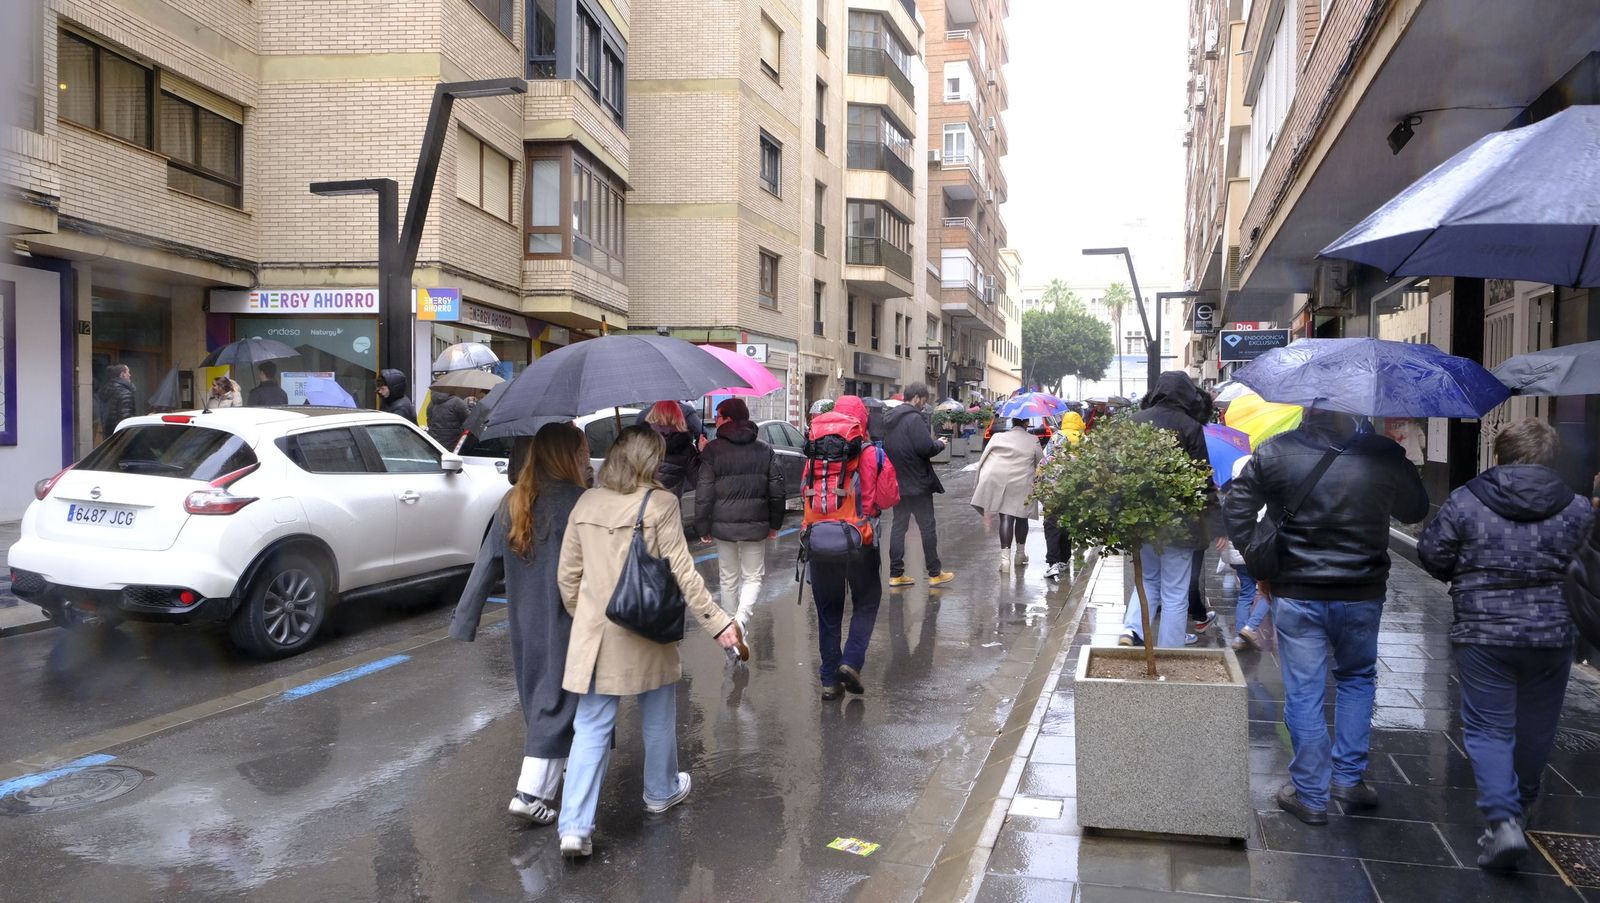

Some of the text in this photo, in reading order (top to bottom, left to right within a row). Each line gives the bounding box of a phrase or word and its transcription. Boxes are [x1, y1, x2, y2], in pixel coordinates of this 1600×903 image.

[250, 292, 374, 308] ENERGY AHORRO
[423, 296, 452, 304] ENERGY
[423, 304, 452, 312] AHORRO
[469, 306, 491, 324] ENERGY
[267, 328, 337, 337] endesa Naturgy
[76, 507, 135, 526] 6487 JCG
